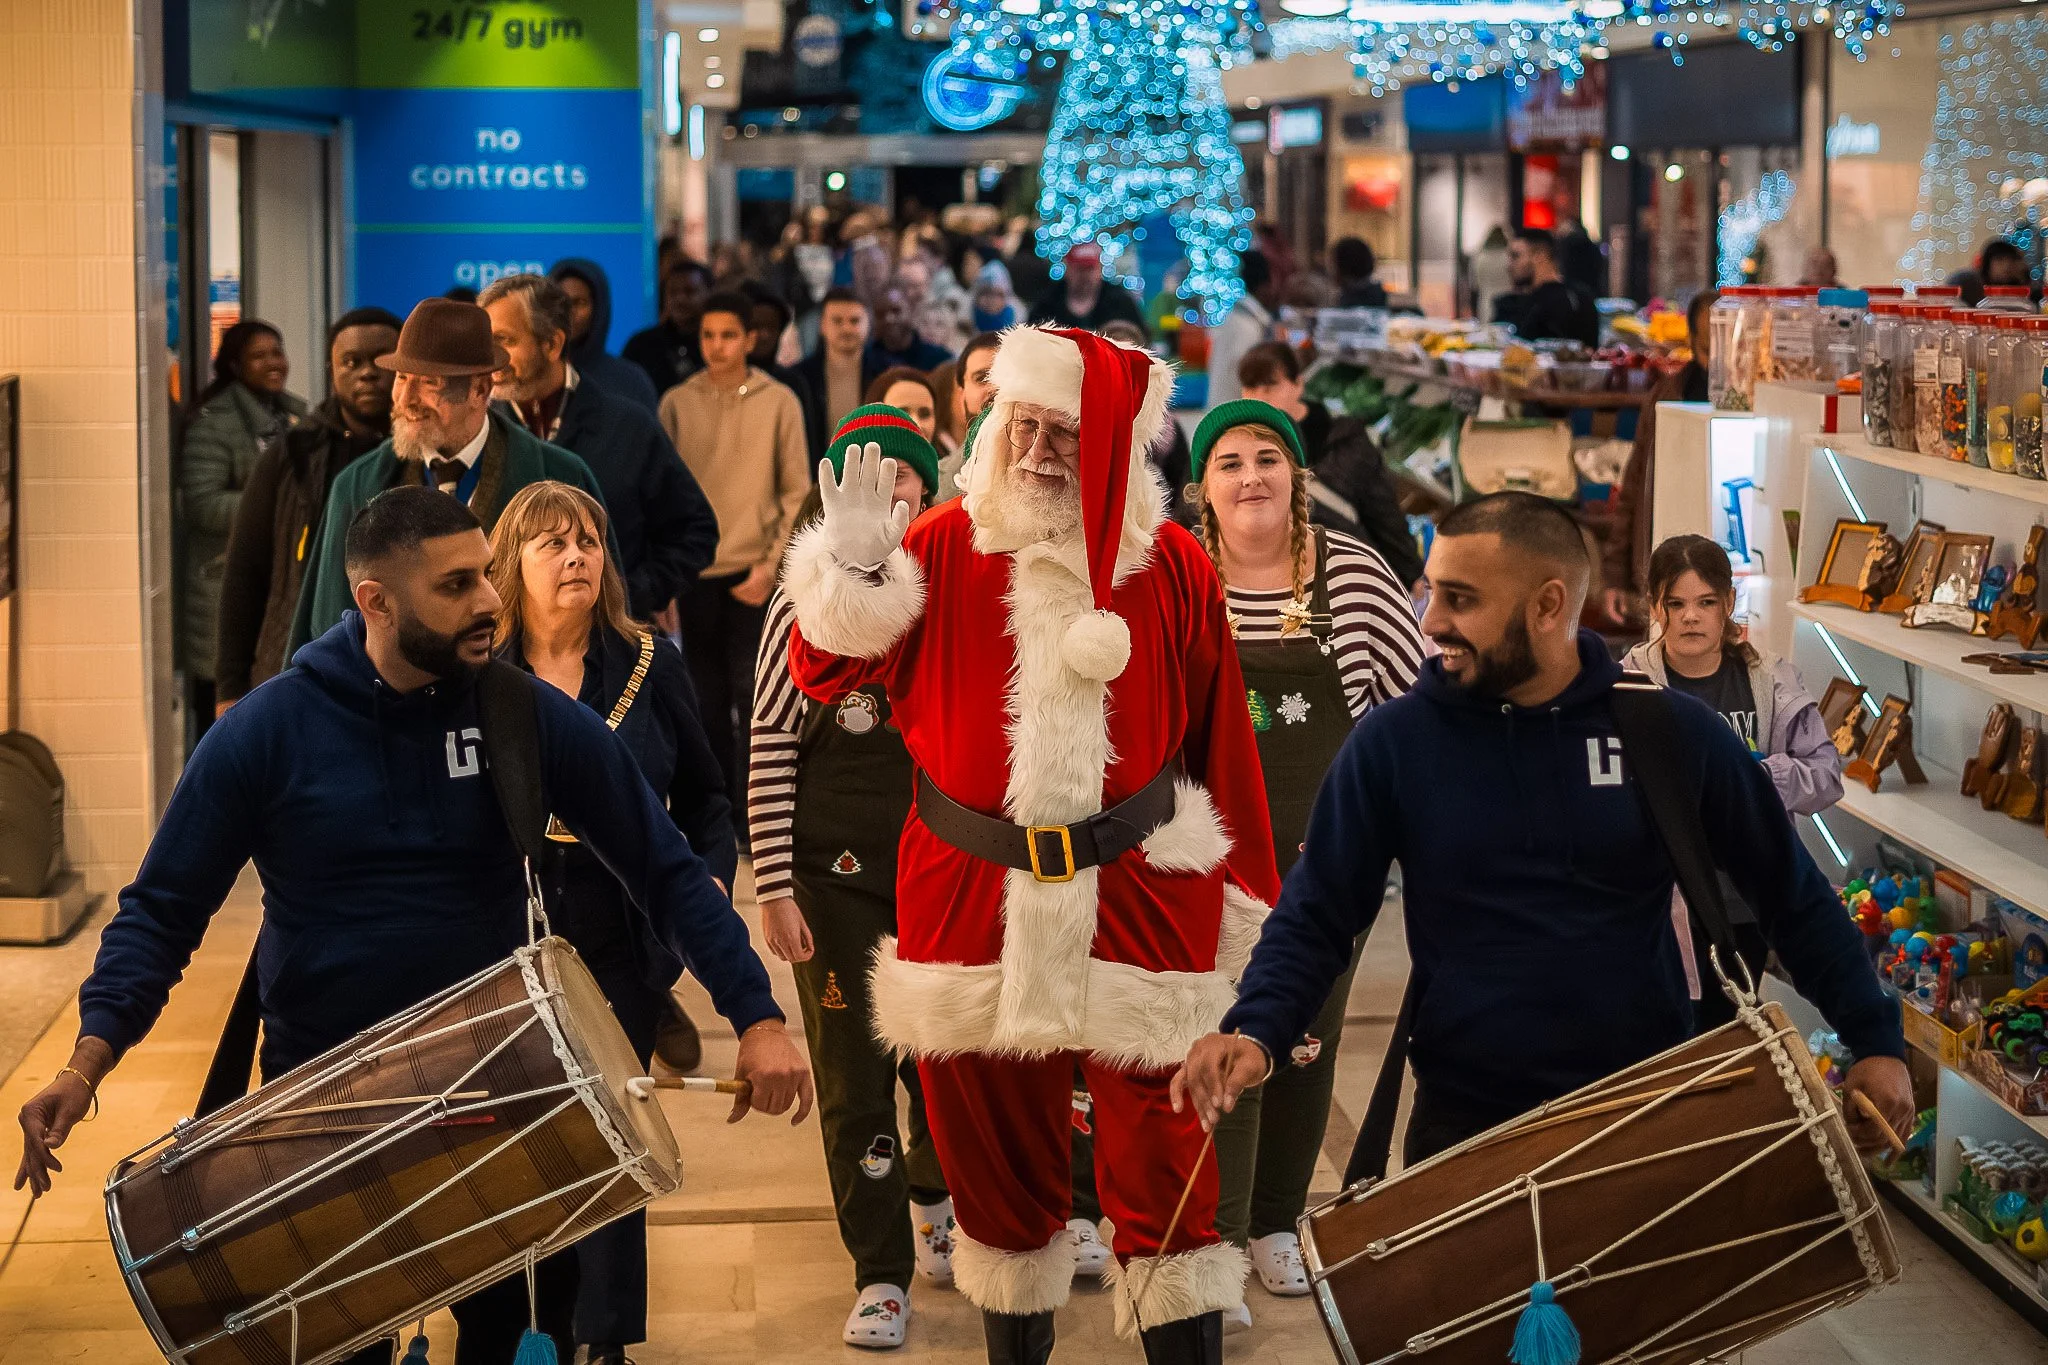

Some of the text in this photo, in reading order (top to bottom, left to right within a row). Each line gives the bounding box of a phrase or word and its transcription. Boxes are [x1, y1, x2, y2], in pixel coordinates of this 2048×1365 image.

[412, 9, 584, 49] 24/7 gym
[476, 127, 522, 152] no
[410, 161, 588, 190] contracts
